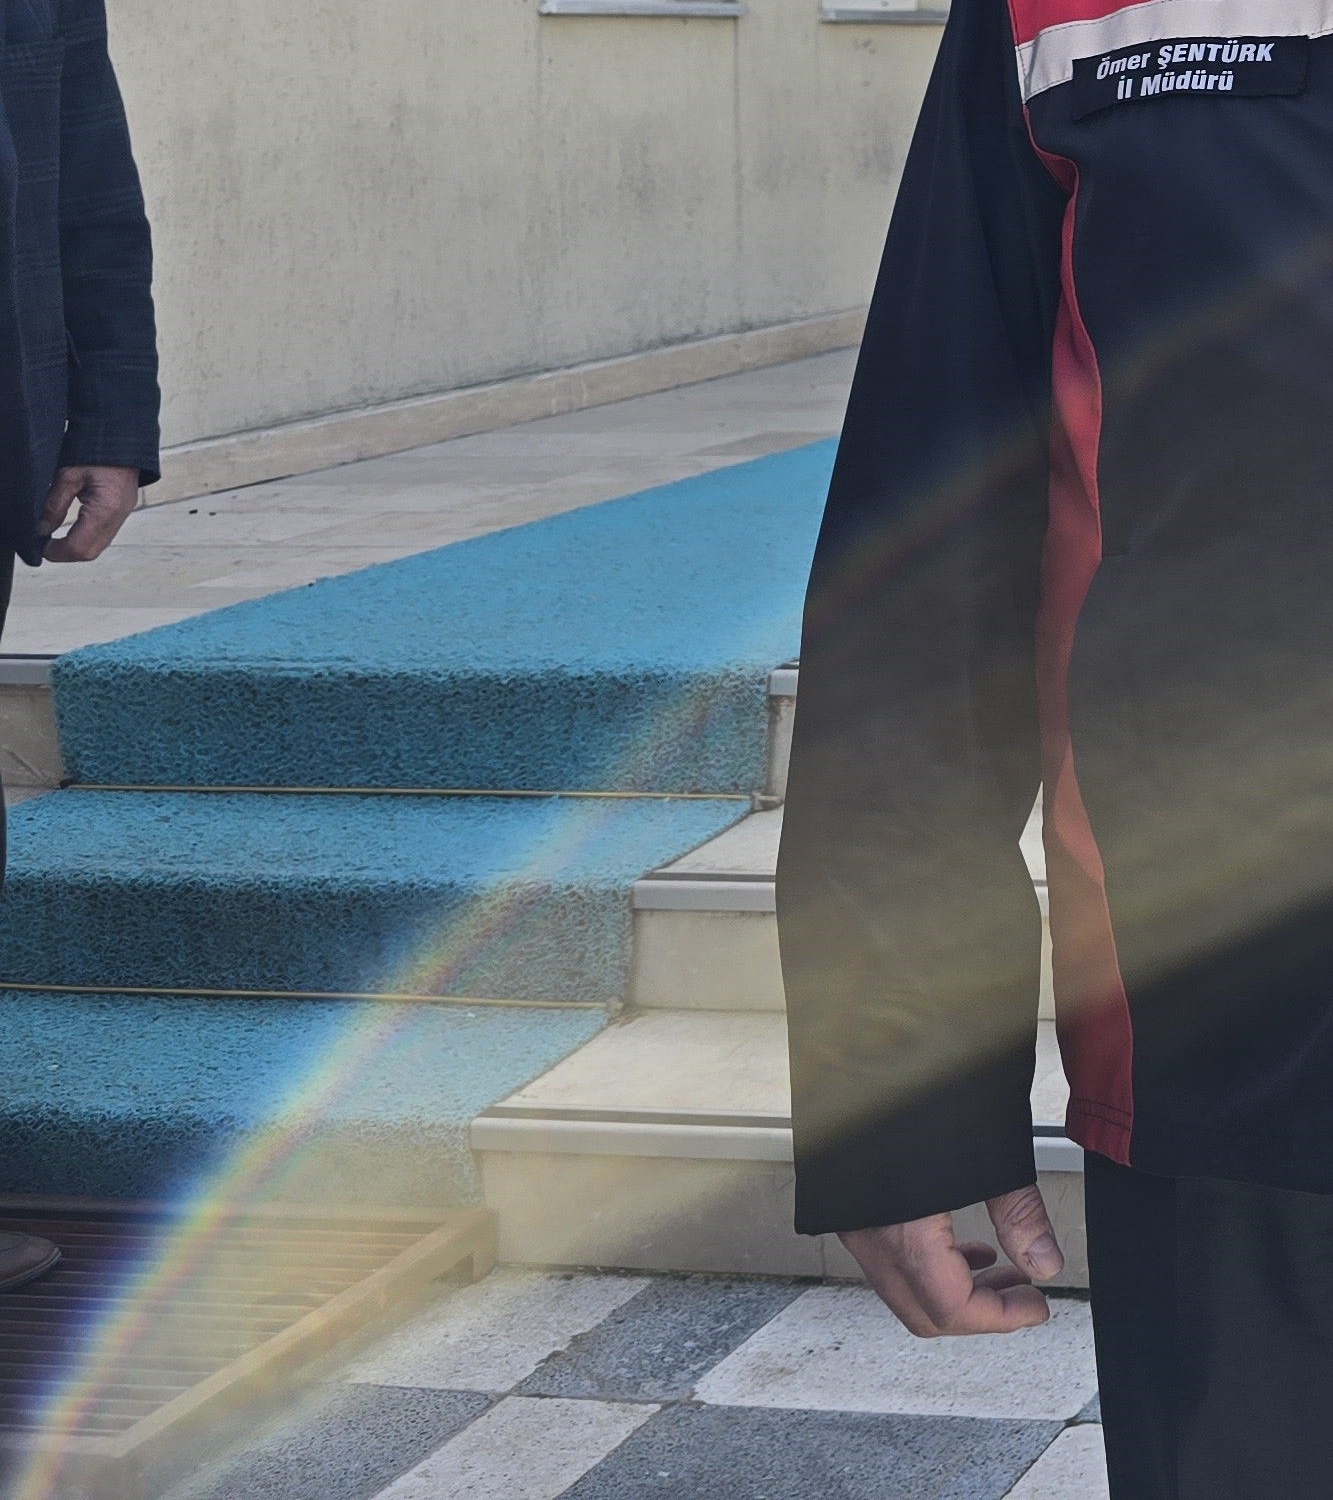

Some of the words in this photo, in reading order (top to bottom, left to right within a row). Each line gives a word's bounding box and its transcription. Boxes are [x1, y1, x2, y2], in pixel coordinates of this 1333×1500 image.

[1096, 52, 1151, 80] Ömer
[1158, 41, 1275, 70] ŞENTÜRK
[1140, 70, 1234, 97] Müdürü
